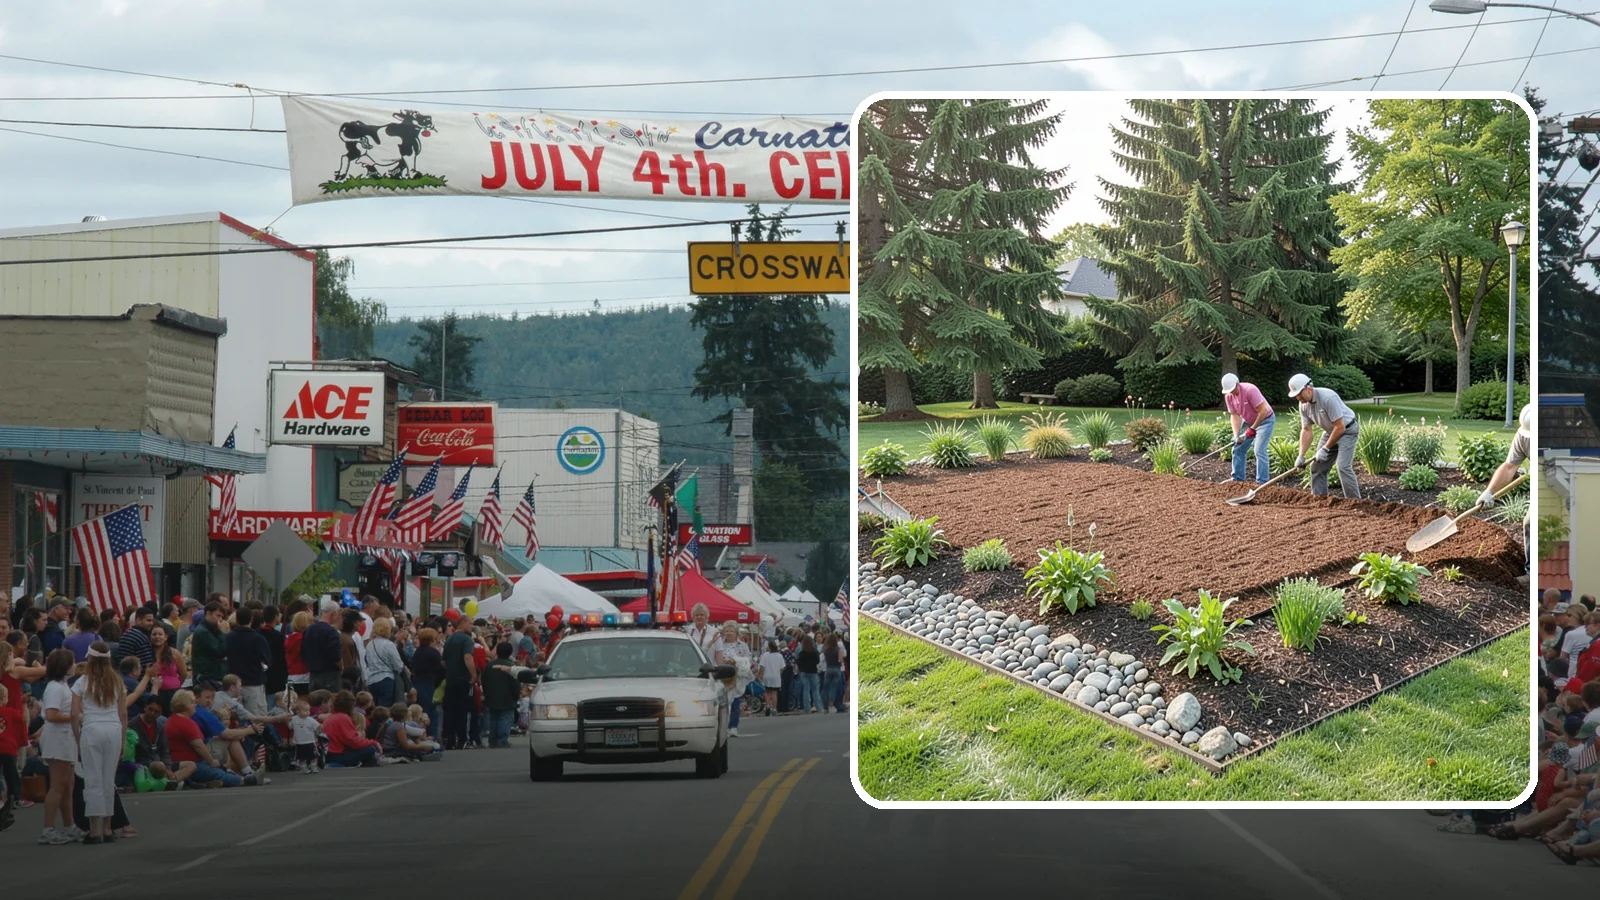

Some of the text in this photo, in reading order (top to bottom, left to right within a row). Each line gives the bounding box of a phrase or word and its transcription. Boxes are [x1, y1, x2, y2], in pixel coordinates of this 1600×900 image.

[695, 121, 850, 150] Carnat
[481, 140, 605, 193] JULY
[632, 150, 746, 198] 4th.
[696, 254, 850, 280] CROSSWA
[283, 380, 374, 420] ACE
[283, 421, 371, 436] Hardware
[416, 428, 477, 447] Coca-Cola
[354, 467, 386, 480] Simpl
[96, 484, 124, 495] Vincent
[126, 485, 135, 495] de
[138, 486, 155, 495] Paul
[213, 516, 330, 535] HARDARE
[688, 526, 741, 535] CRNATION
[699, 535, 730, 543] GLASS
